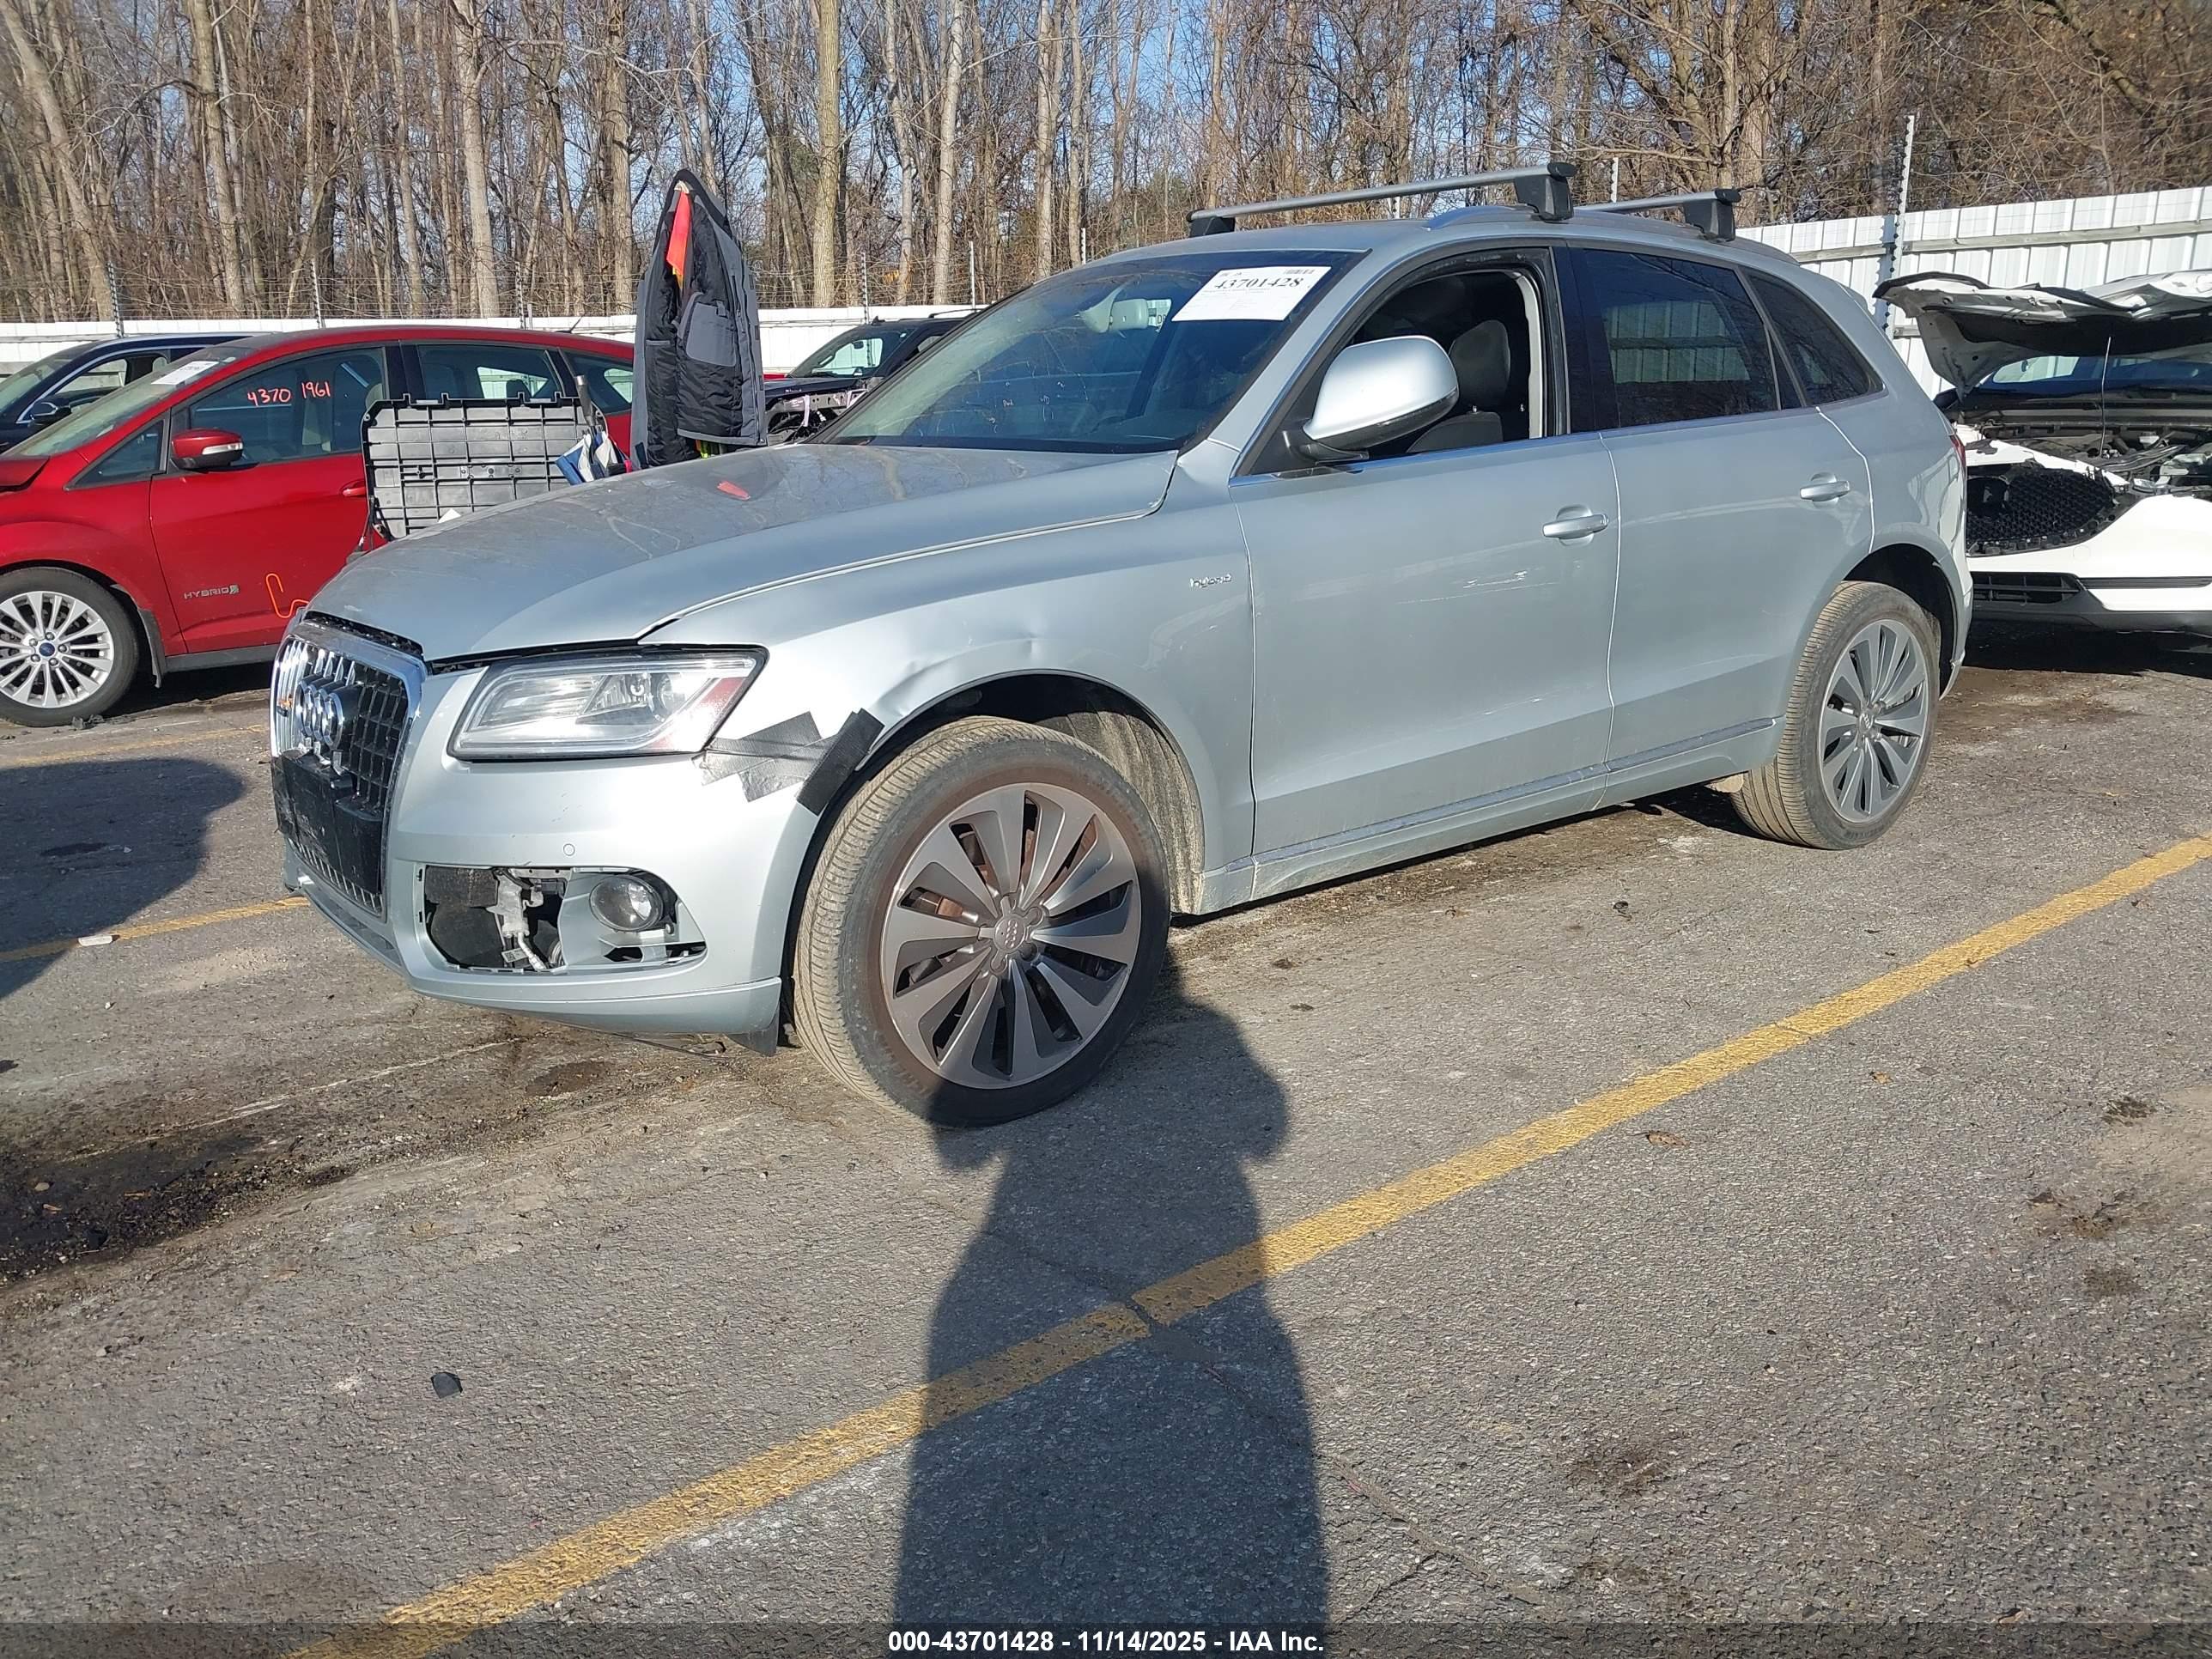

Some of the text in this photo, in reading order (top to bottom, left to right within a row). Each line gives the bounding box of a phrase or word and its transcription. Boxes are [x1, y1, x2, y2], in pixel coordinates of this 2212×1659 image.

[1214, 276, 1304, 289] 43701428
[246, 381, 331, 407] 4370 1961
[183, 586, 229, 599] HYBRID
